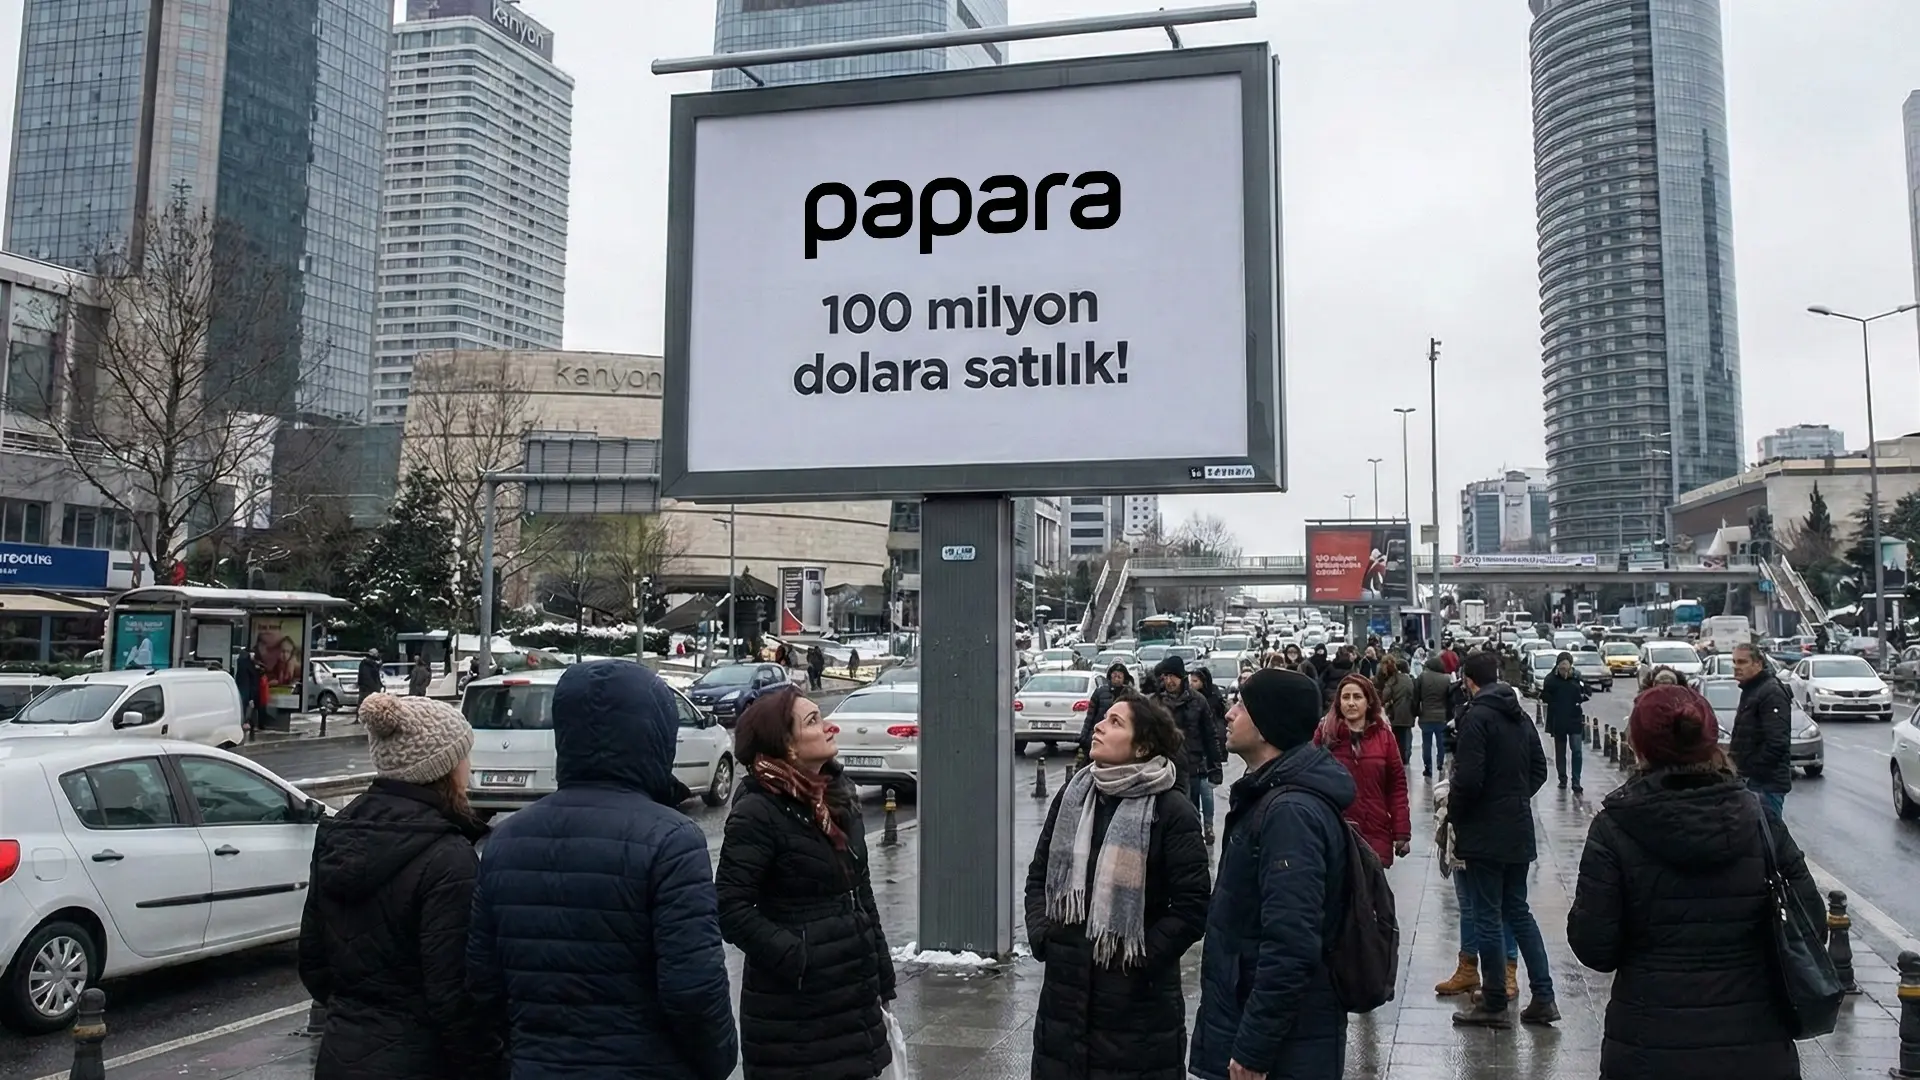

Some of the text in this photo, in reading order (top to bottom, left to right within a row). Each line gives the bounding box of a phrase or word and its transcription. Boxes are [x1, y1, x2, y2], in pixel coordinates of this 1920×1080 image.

[493, 0, 544, 50] kanyon
[804, 170, 1121, 260] papara
[822, 284, 1098, 336] 100 milyon
[556, 358, 662, 393] kanyon
[793, 340, 1128, 395] dolara satılık!
